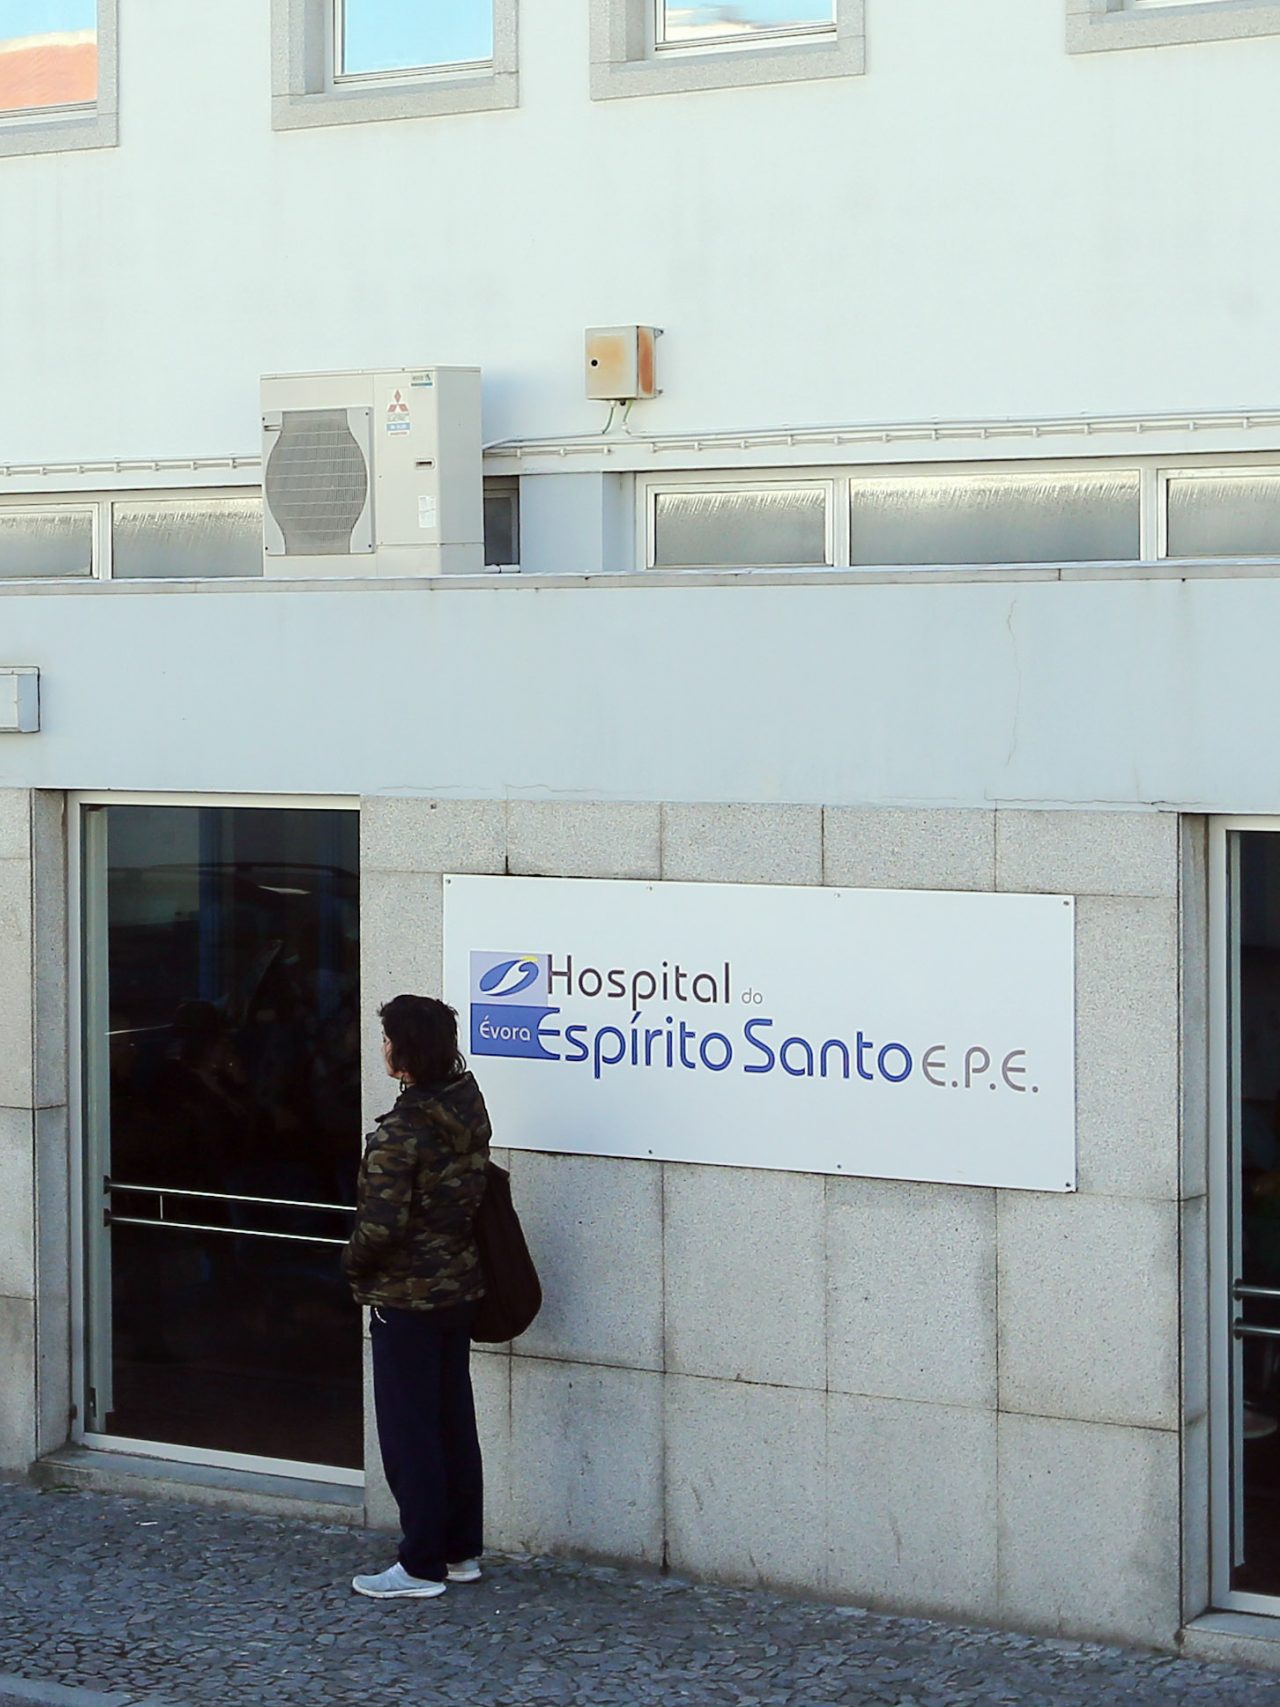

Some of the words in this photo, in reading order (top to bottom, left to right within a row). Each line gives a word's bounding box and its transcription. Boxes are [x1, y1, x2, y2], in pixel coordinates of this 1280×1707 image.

[548, 954, 730, 1011] Hospital
[741, 987, 763, 1004] do
[479, 1015, 531, 1041] Évora
[537, 1011, 733, 1079] Espírito
[743, 1018, 913, 1083] Santo
[922, 1044, 1039, 1093] E.P.E.
